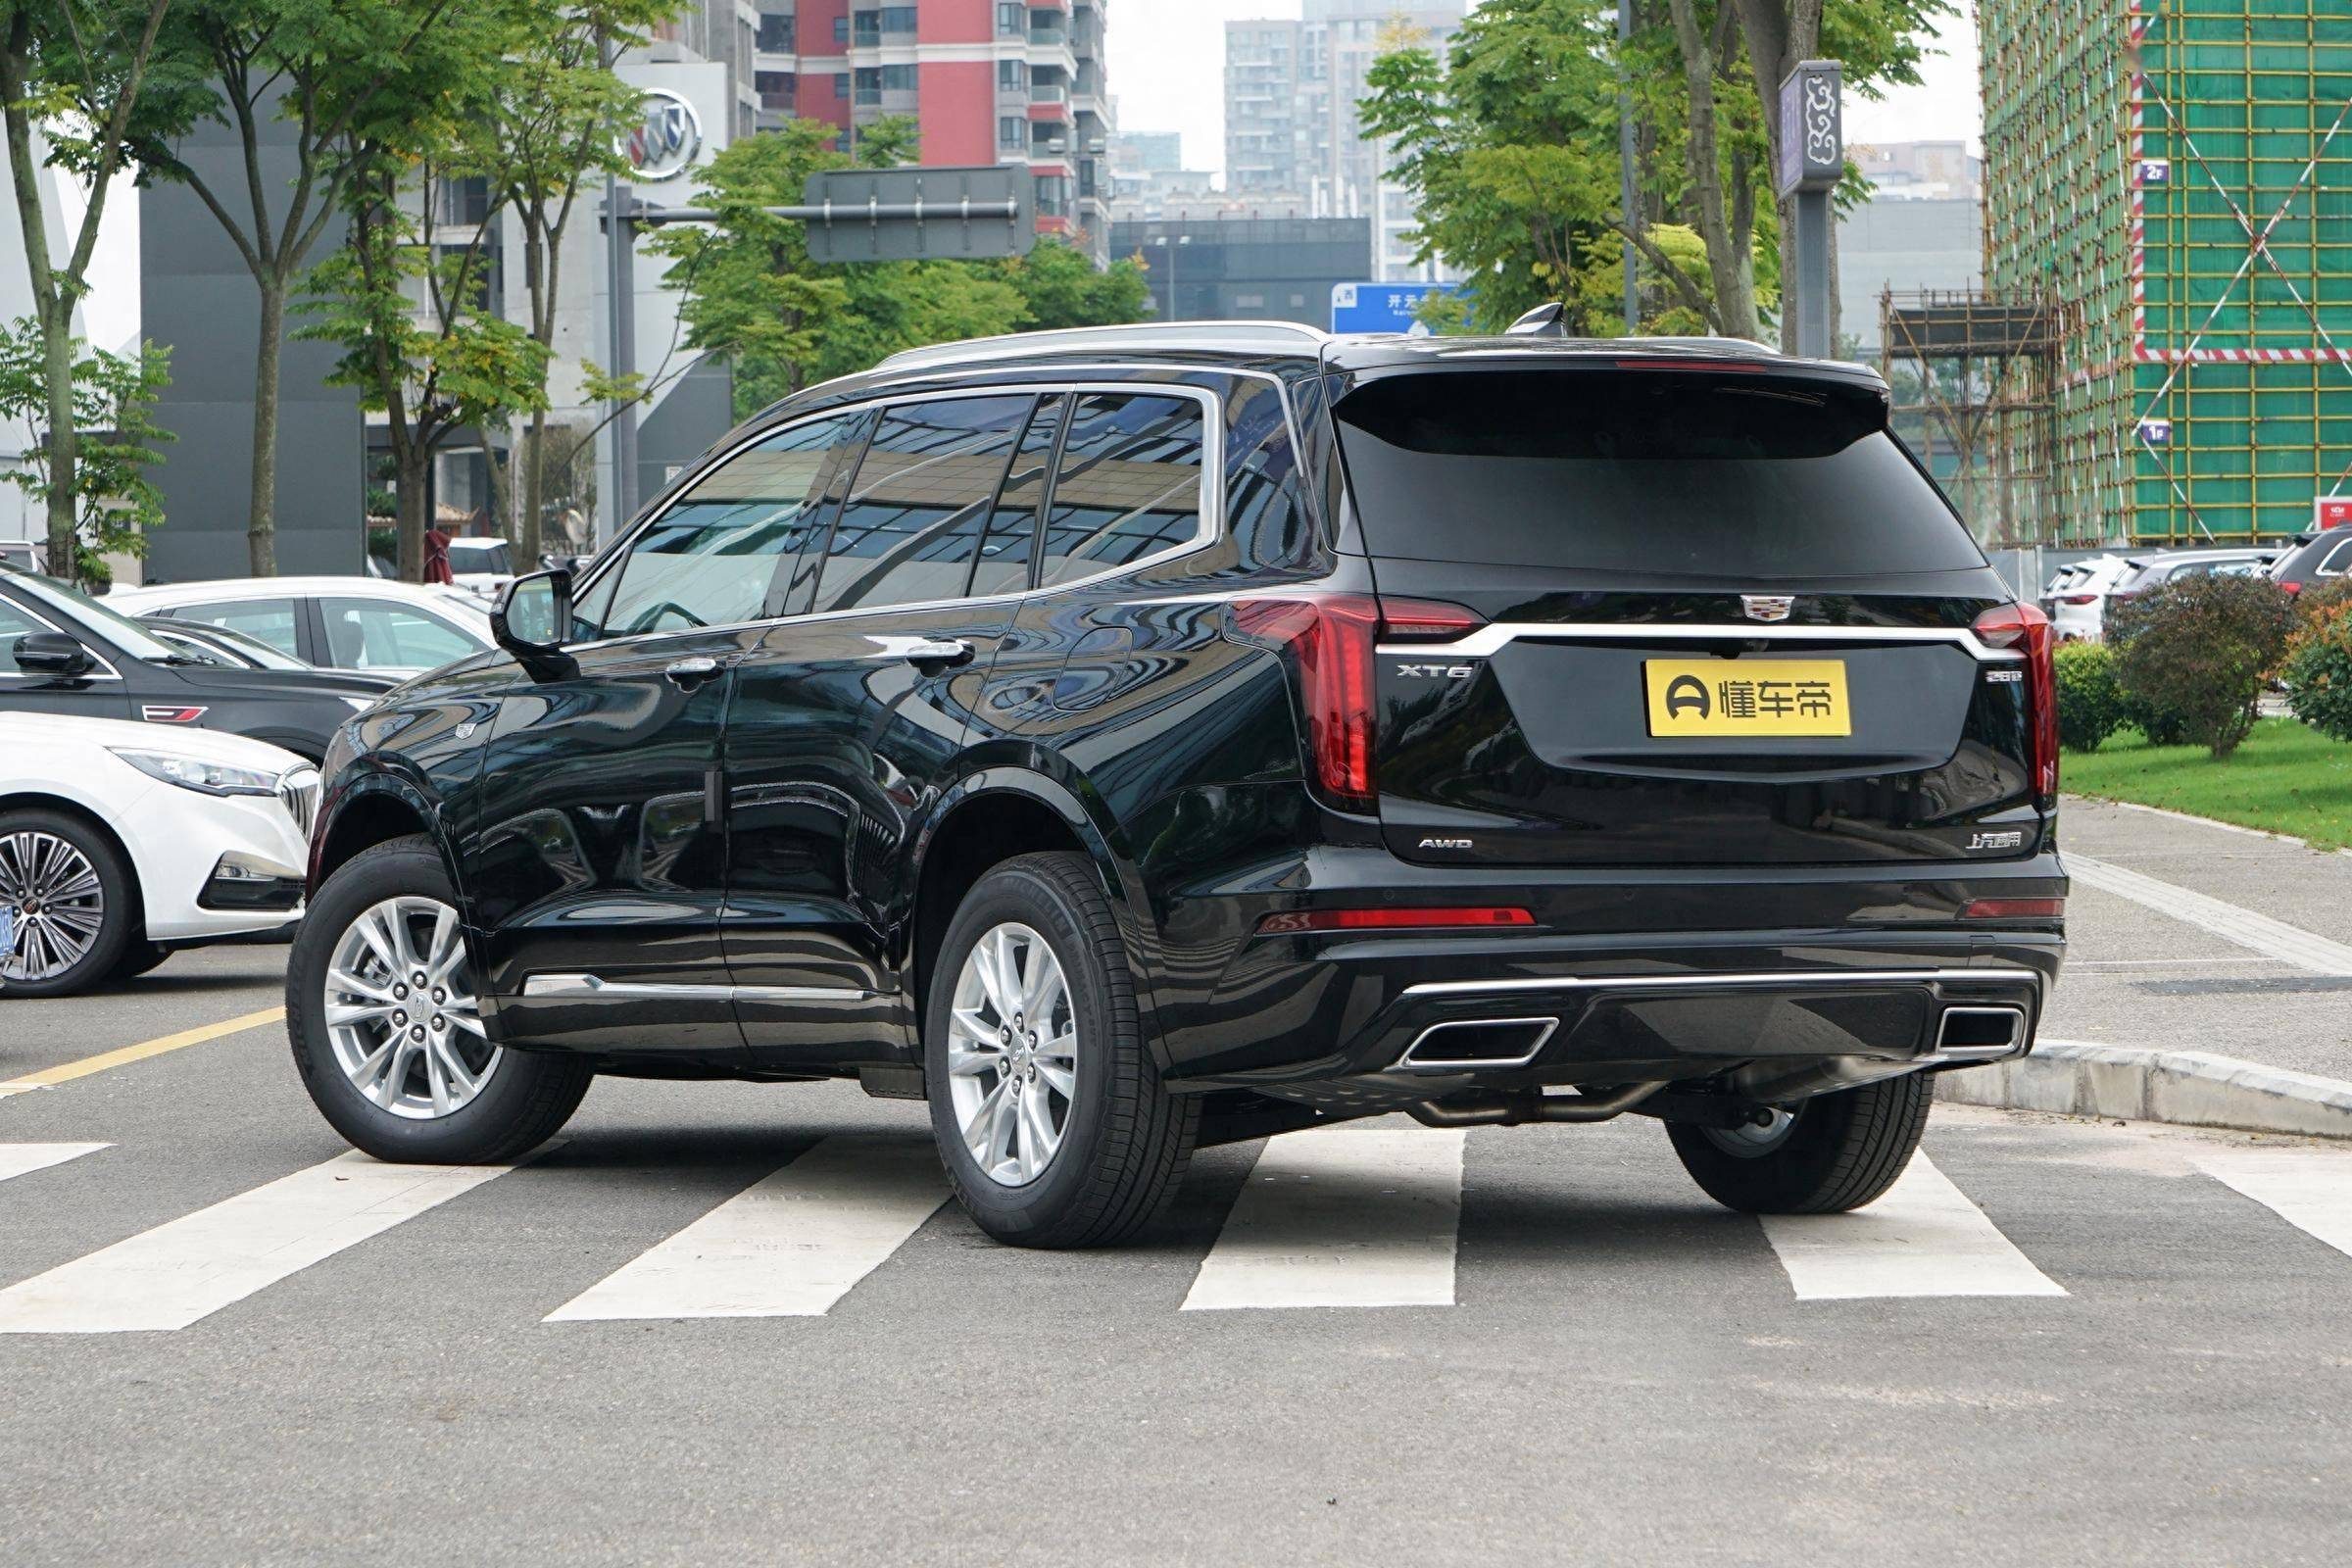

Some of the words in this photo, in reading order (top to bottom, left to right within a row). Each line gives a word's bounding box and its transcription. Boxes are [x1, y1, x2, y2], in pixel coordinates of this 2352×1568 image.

[2146, 165, 2164, 180] 2F
[2148, 425, 2164, 440] 1F
[1396, 664, 1473, 677] XT6
[1719, 680, 1833, 718] 懂车帝
[1418, 839, 1473, 849] AWD
[1965, 832, 2022, 849] 上汽通用
